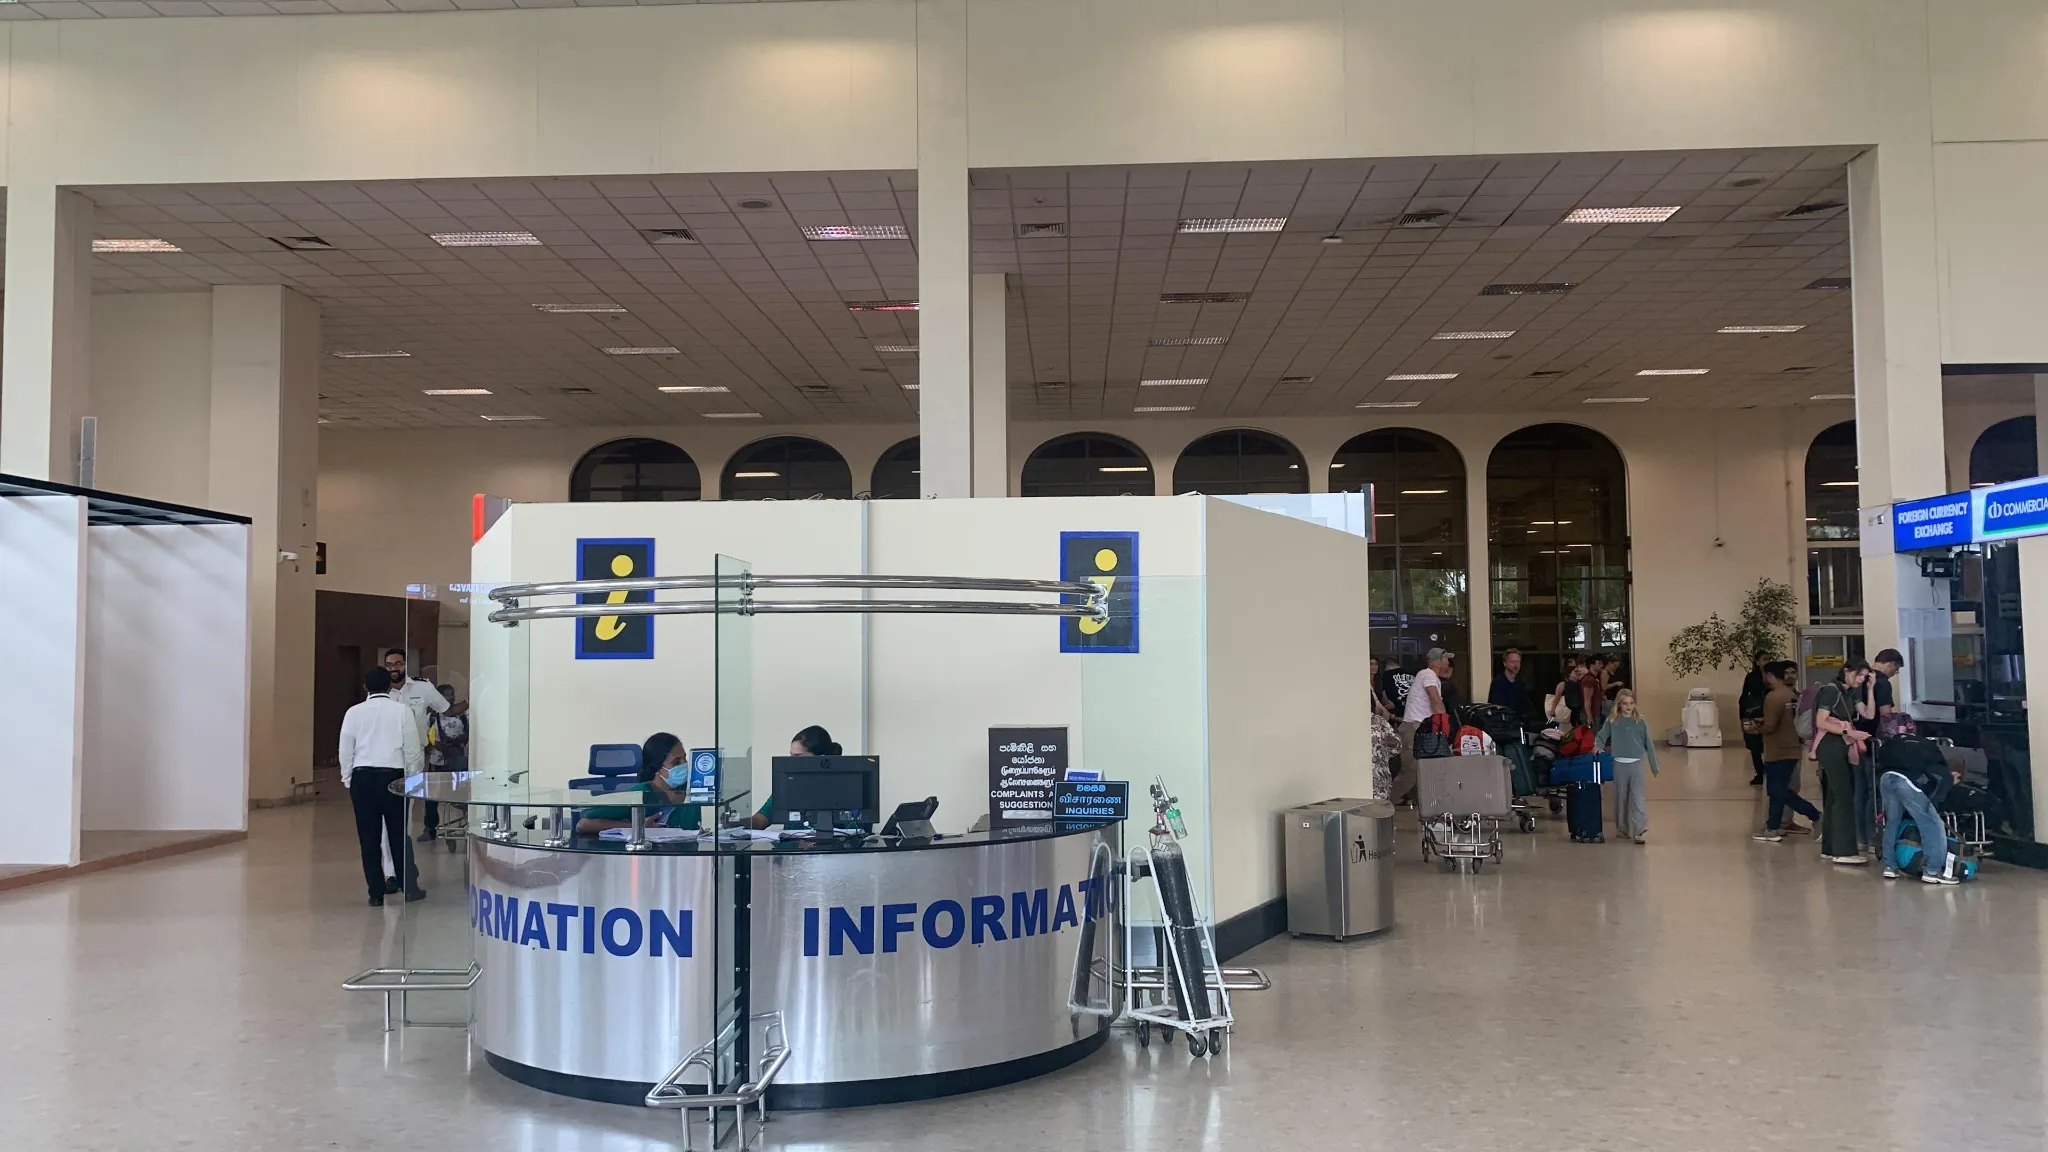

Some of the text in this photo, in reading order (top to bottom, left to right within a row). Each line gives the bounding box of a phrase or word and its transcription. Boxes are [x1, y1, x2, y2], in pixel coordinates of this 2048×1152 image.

[1898, 501, 1968, 525] FOREIGN CURRENCY
[2003, 497, 2048, 516] COMMERCIA
[1914, 521, 1954, 539] EXCHANGE
[991, 790, 1044, 798] COMPLAINTS
[1059, 793, 1122, 805] விசாரணை
[1065, 807, 1115, 815] INQUIRIES
